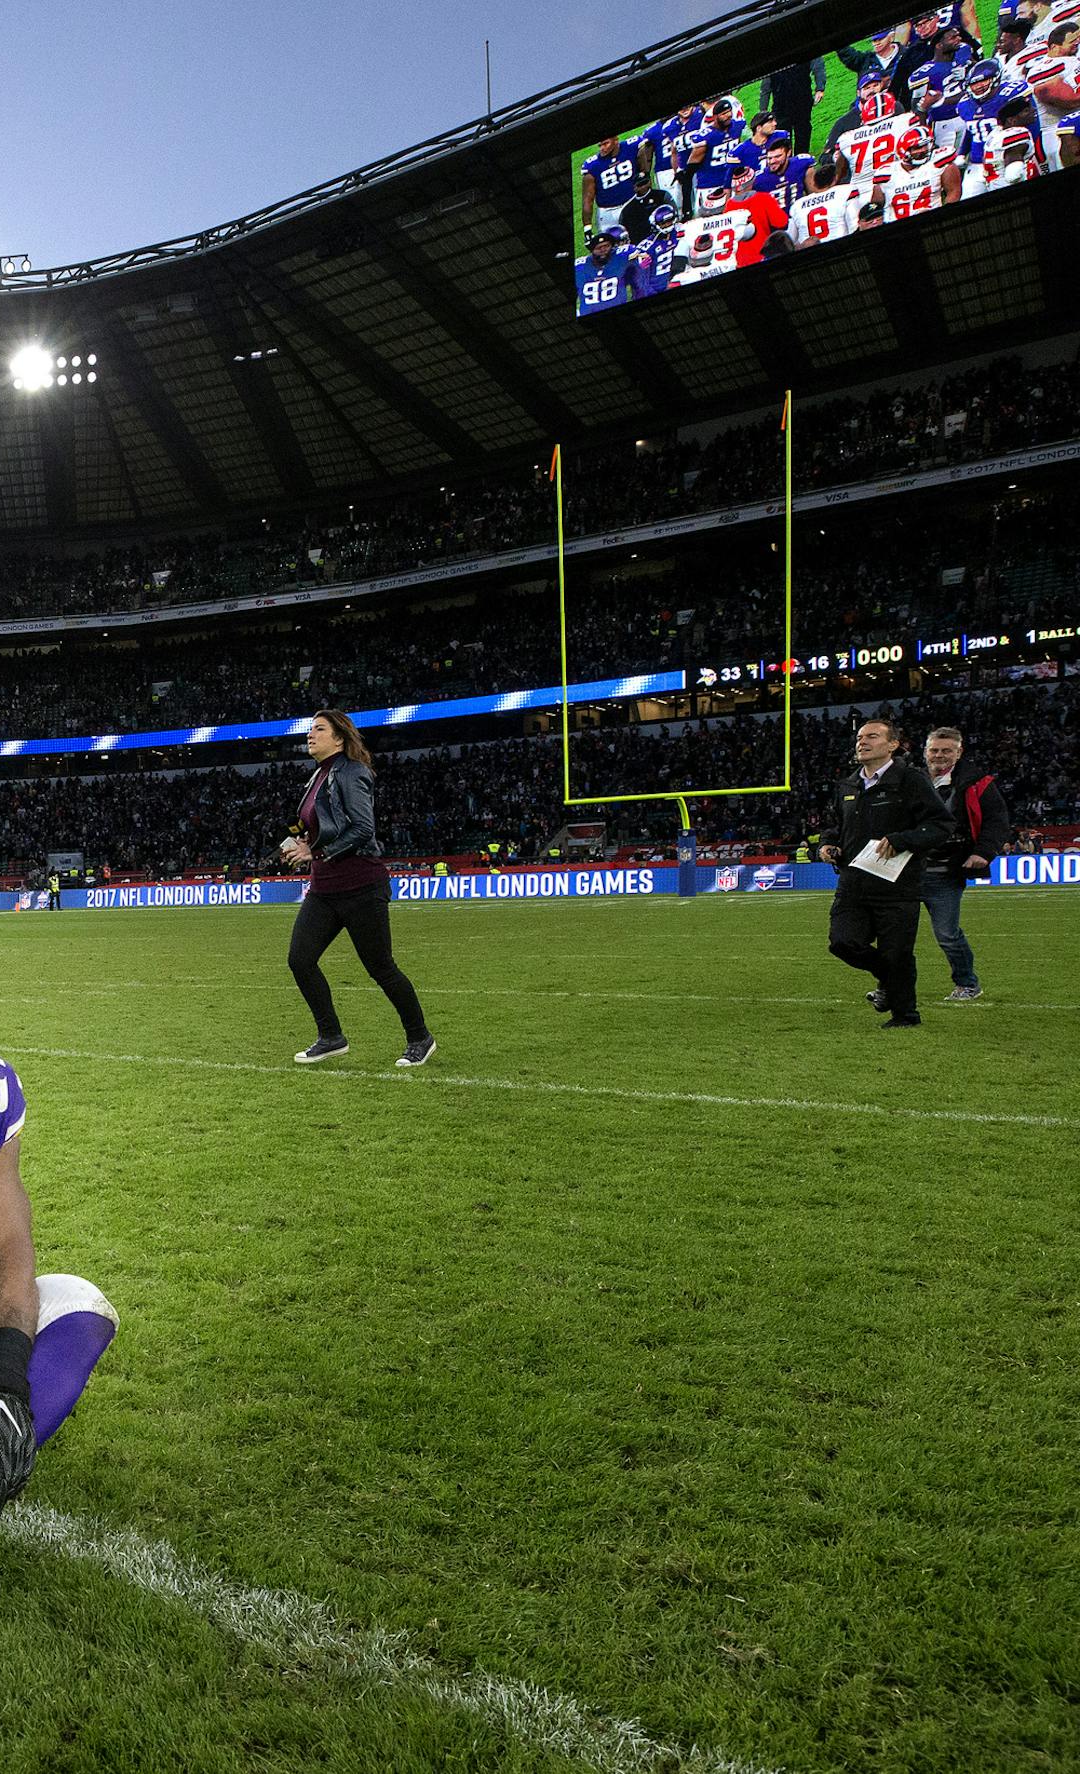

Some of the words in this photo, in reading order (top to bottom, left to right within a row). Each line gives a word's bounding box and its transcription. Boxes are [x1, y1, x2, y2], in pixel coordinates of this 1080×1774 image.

[854, 121, 893, 140] COLEMAN
[850, 133, 895, 173] 72
[601, 159, 633, 190] 69
[895, 179, 930, 194] CLEVELAND
[802, 191, 835, 208] KESSLER
[892, 186, 932, 220] 64
[703, 217, 732, 231] MARTIN
[808, 206, 829, 239] 6
[583, 277, 619, 304] 98
[968, 463, 996, 475] 2017
[826, 492, 849, 502] VISA
[295, 593, 311, 601] VISA
[967, 636, 997, 650] 2ND
[1000, 635, 1010, 646] &
[1026, 630, 1036, 644] 1
[1038, 627, 1076, 641] BALL
[857, 645, 904, 667] 0:00
[922, 642, 951, 656] 4TH
[807, 656, 829, 671] 16
[838, 658, 848, 670] 2
[720, 667, 742, 681] 33
[750, 669, 758, 680] 1
[398, 878, 439, 900] 2017
[443, 876, 480, 899] NFL
[486, 872, 568, 898] LONDON
[576, 869, 654, 896] GAMES
[87, 889, 117, 908] 2017
[119, 887, 141, 907] NFL
[147, 885, 204, 906] LONDON
[209, 883, 261, 905] GAMES
